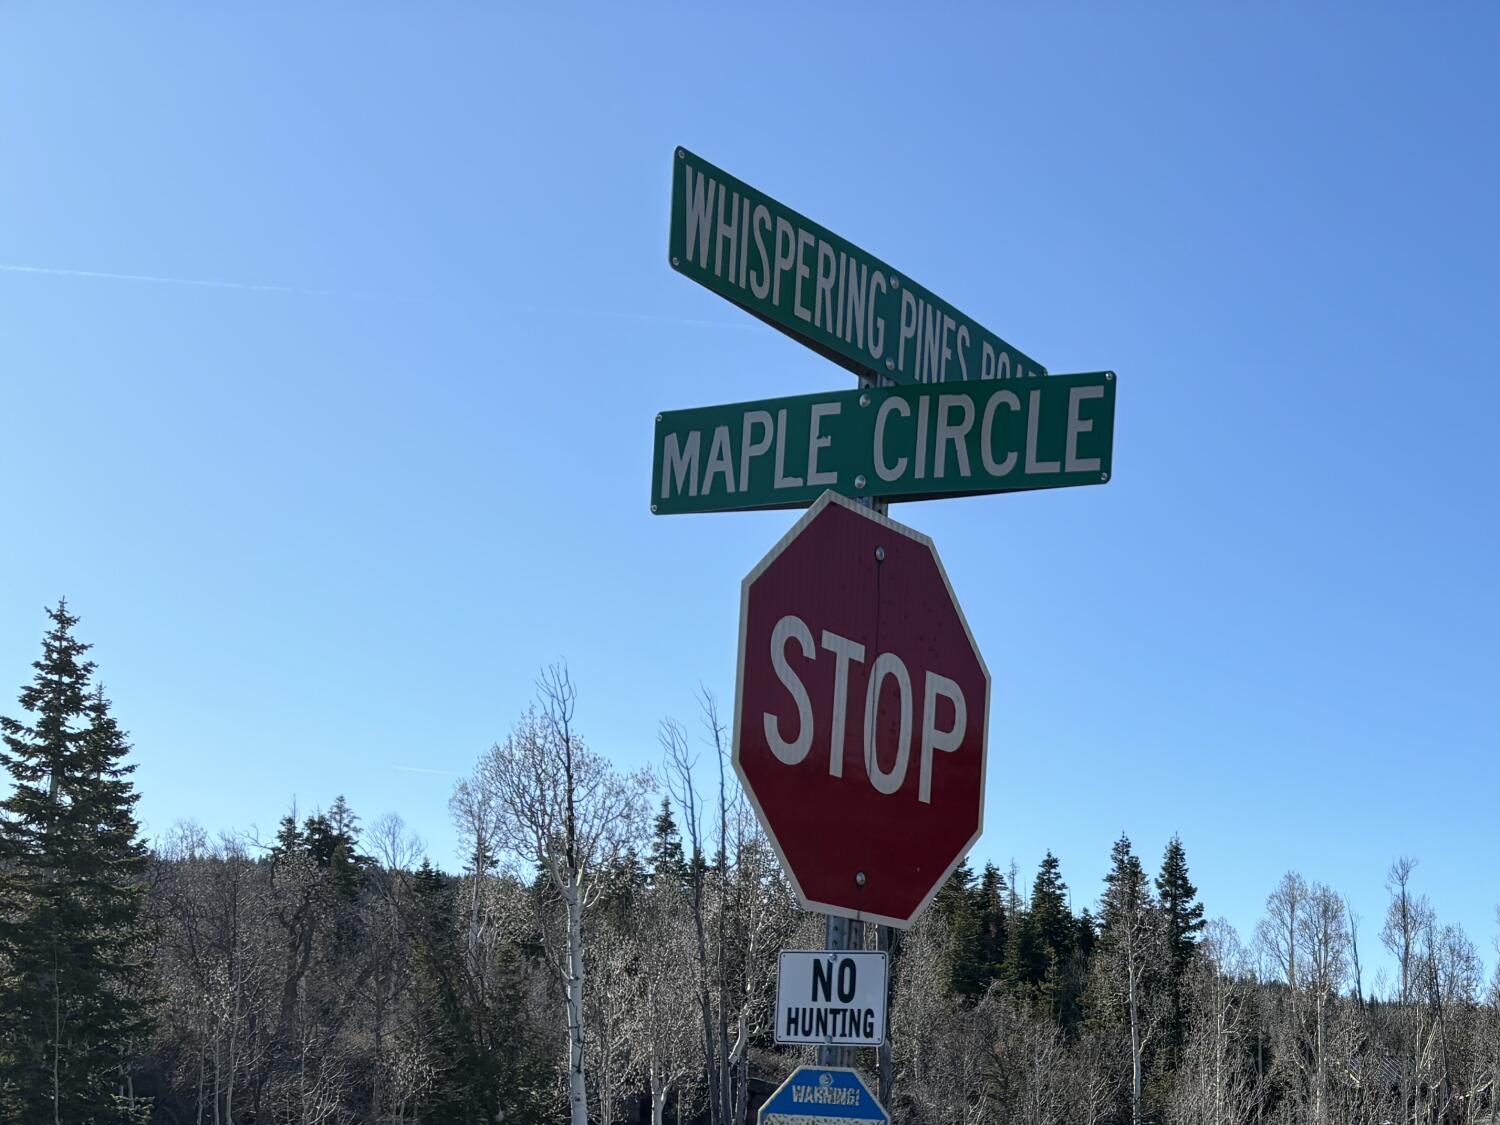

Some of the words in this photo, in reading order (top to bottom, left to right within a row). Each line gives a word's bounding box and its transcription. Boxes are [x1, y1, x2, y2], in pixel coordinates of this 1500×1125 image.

[685, 164, 888, 359] WHISPERING
[898, 288, 970, 384] PINES
[661, 402, 841, 499] MAPLE
[873, 385, 1105, 482] CIRCLE
[763, 615, 967, 804] STOP
[811, 957, 857, 1003] NO
[786, 1007, 875, 1039] HUNTING
[792, 1085, 860, 1106] WARNING!
